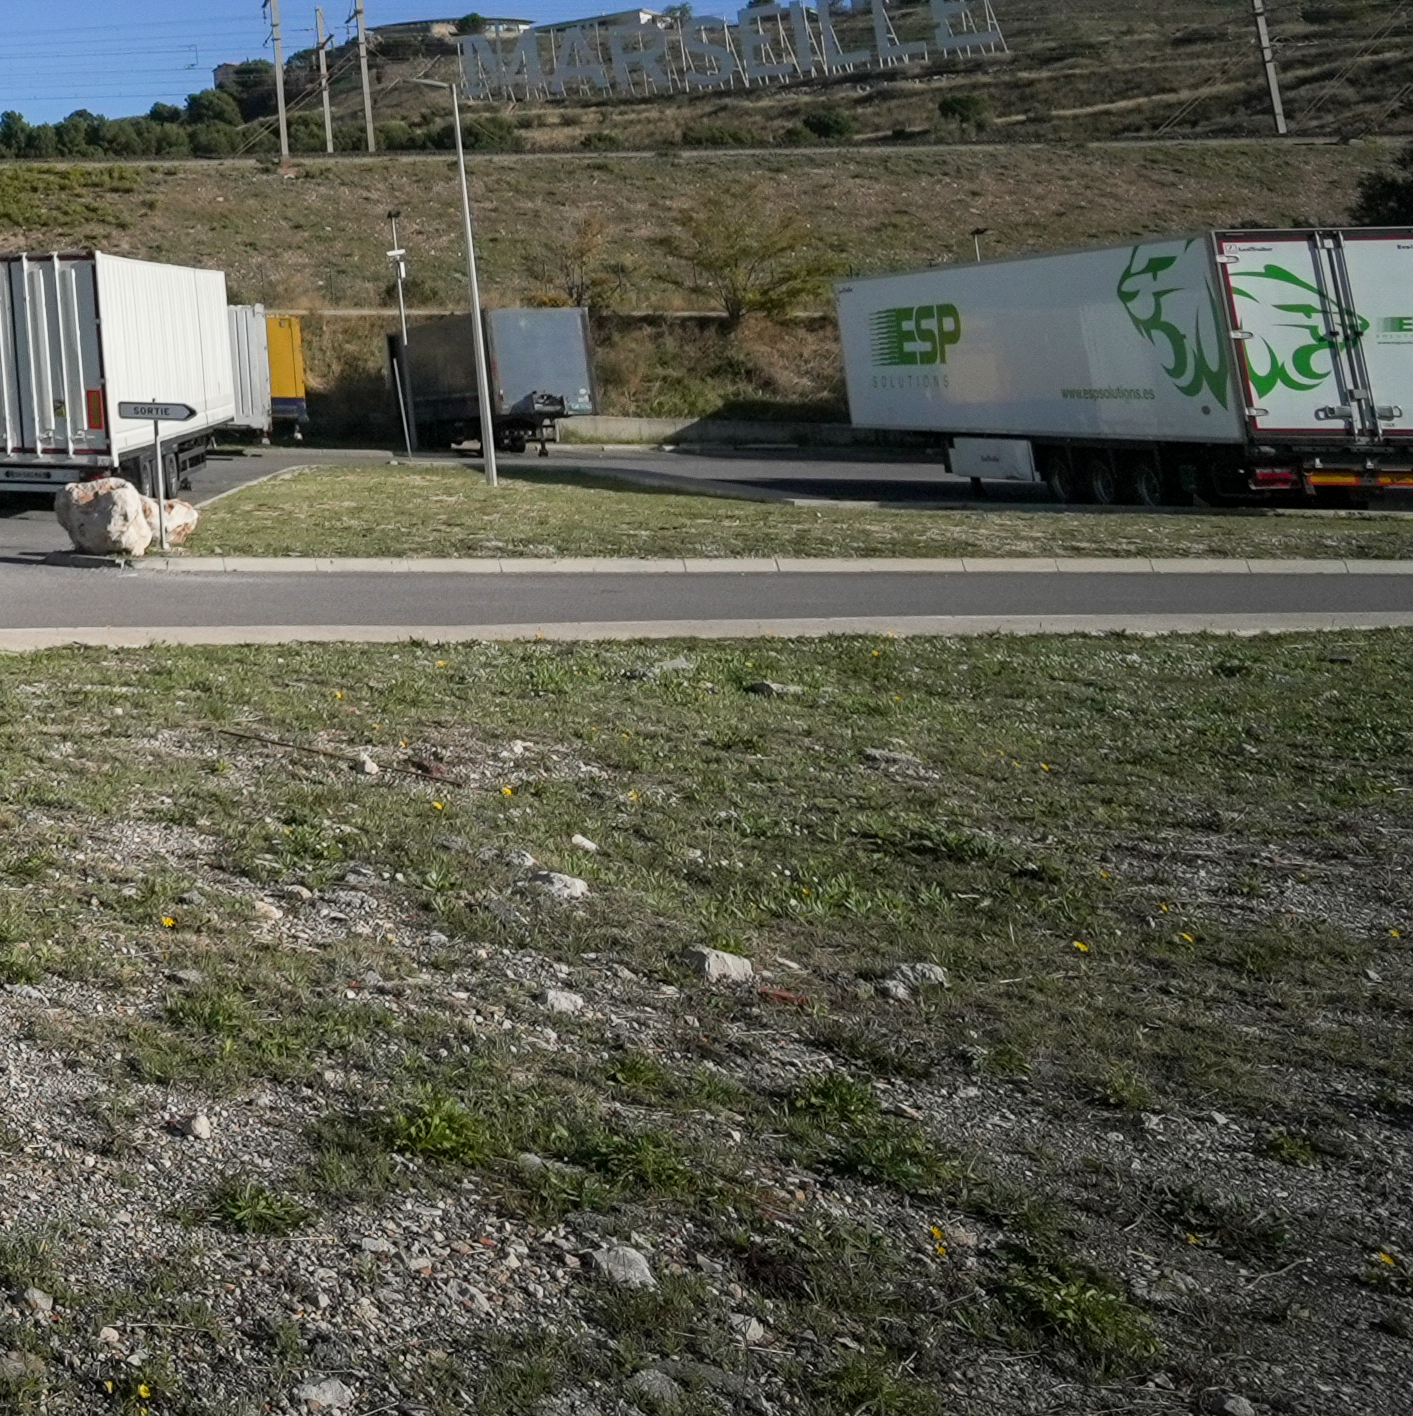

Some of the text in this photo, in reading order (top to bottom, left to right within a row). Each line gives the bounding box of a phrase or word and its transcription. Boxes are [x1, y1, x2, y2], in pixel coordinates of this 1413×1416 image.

[891, 303, 961, 366] ESP
[872, 374, 950, 389] SOLUTIONS
[133, 406, 170, 416] SORTIE
